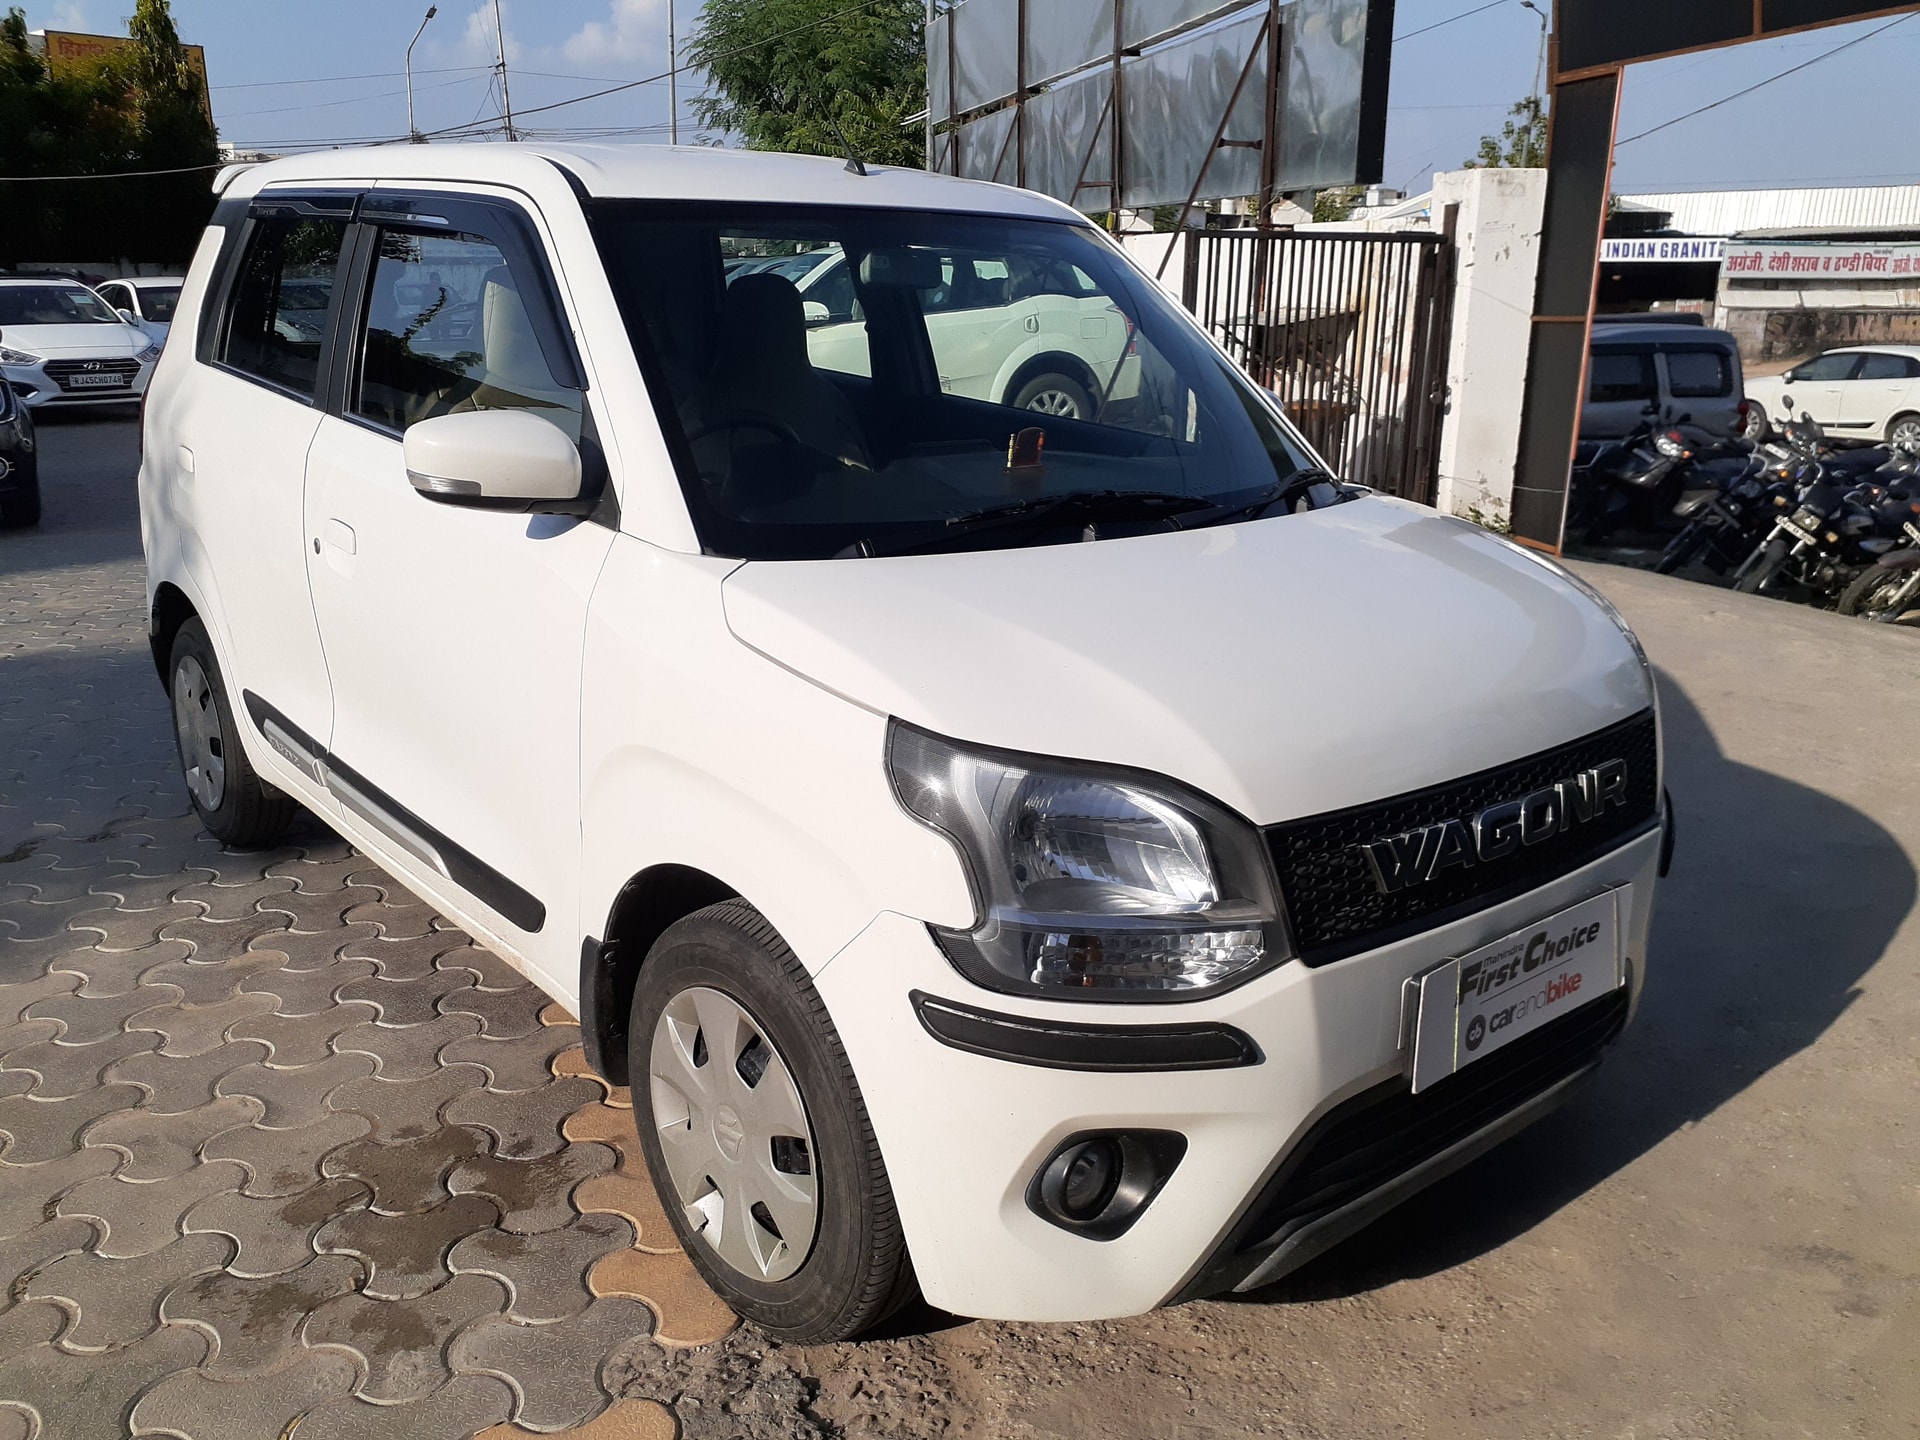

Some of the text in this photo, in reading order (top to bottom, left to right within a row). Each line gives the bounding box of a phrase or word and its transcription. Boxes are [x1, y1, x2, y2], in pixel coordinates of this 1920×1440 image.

[1606, 242, 1656, 258] INDIAN
[1768, 251, 1791, 272] देशी
[1791, 256, 1820, 272] शराब
[1823, 256, 1832, 272] व
[1861, 252, 1889, 272] बियर
[74, 375, 123, 385] RJ45CH0748
[1455, 921, 1600, 1008] First Choice
[1489, 972, 1582, 1033] carandbike
